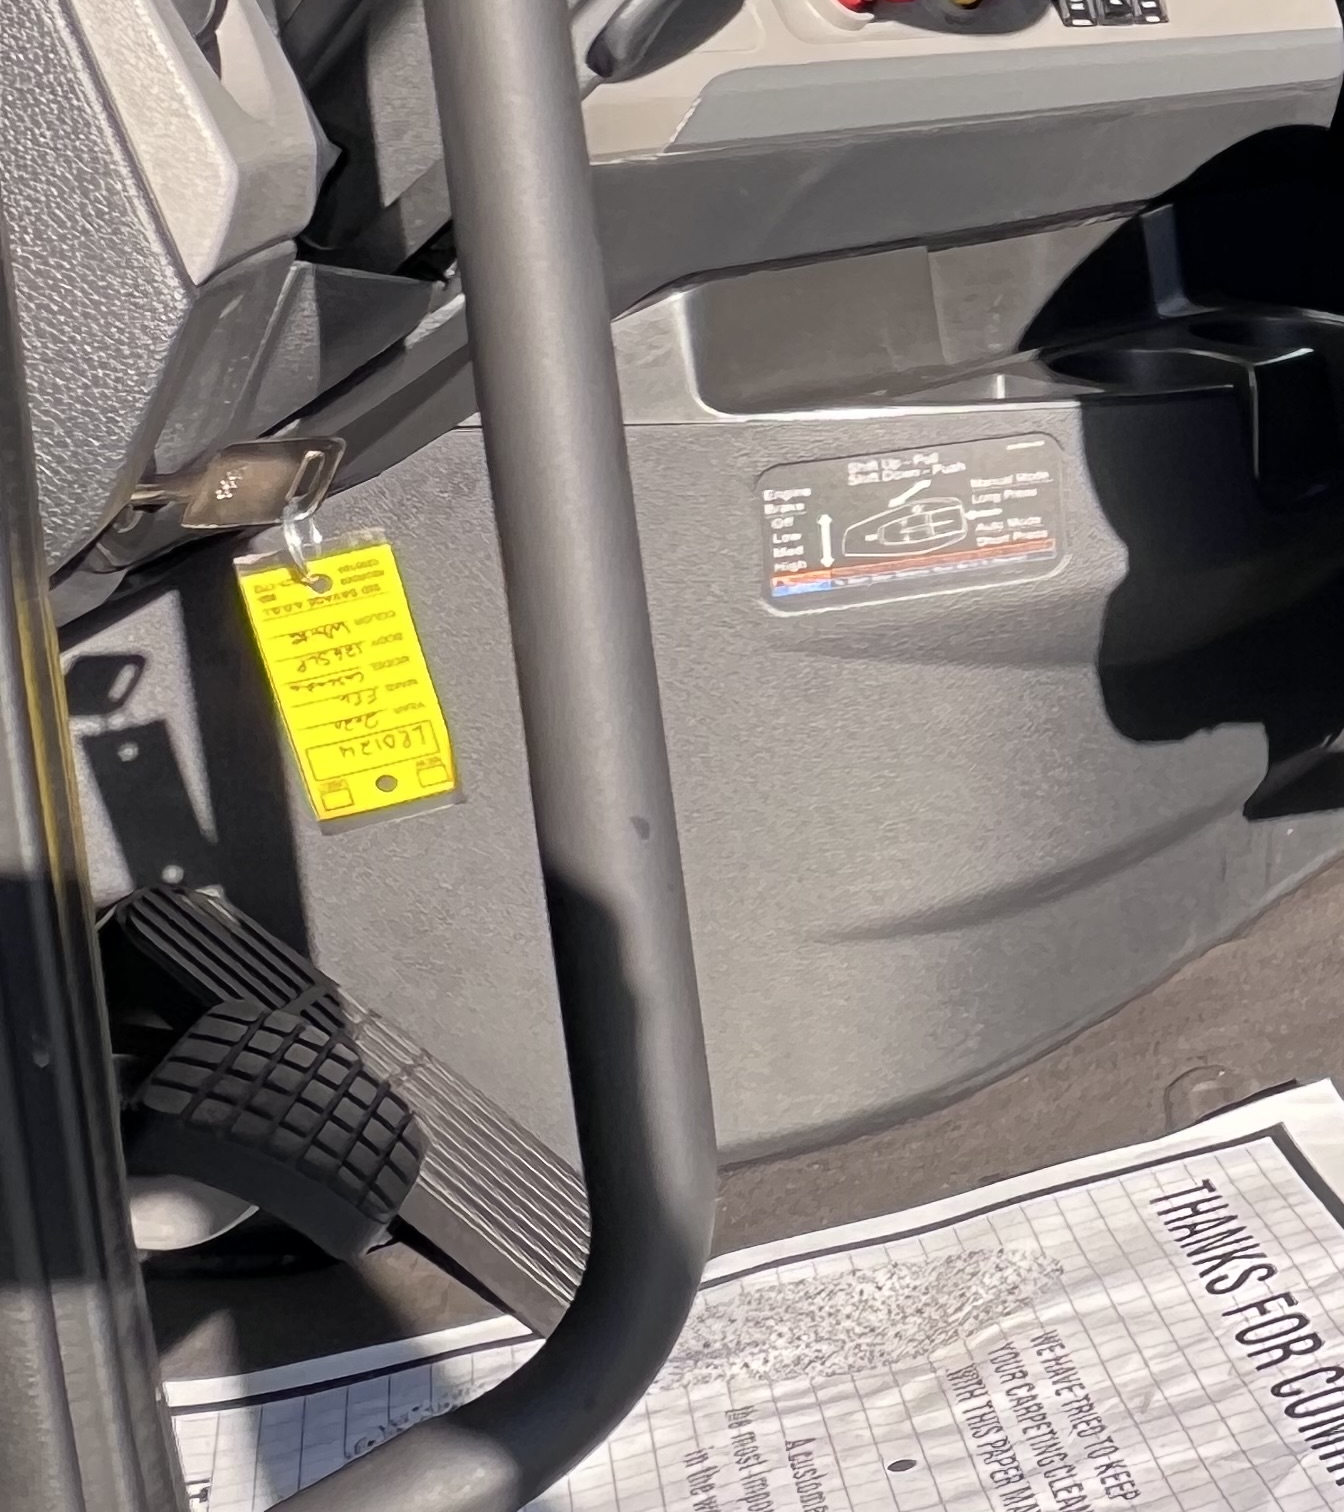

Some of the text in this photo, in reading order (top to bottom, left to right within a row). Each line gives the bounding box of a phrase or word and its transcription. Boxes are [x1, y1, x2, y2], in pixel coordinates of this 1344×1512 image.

[1149, 1179, 1278, 1296] THANKS
[1221, 1291, 1327, 1372] FOR
[946, 1363, 990, 1403] WITH
[988, 1341, 1029, 1384] YOUR
[962, 1400, 1003, 1439] THIS
[1005, 1382, 1069, 1468] CARPETING
[1030, 1329, 1141, 1500] WE HAVE TRIED TO KEEP
[730, 1431, 771, 1472] most
[976, 1435, 1025, 1489] PAPER
[686, 1465, 722, 1496] the
